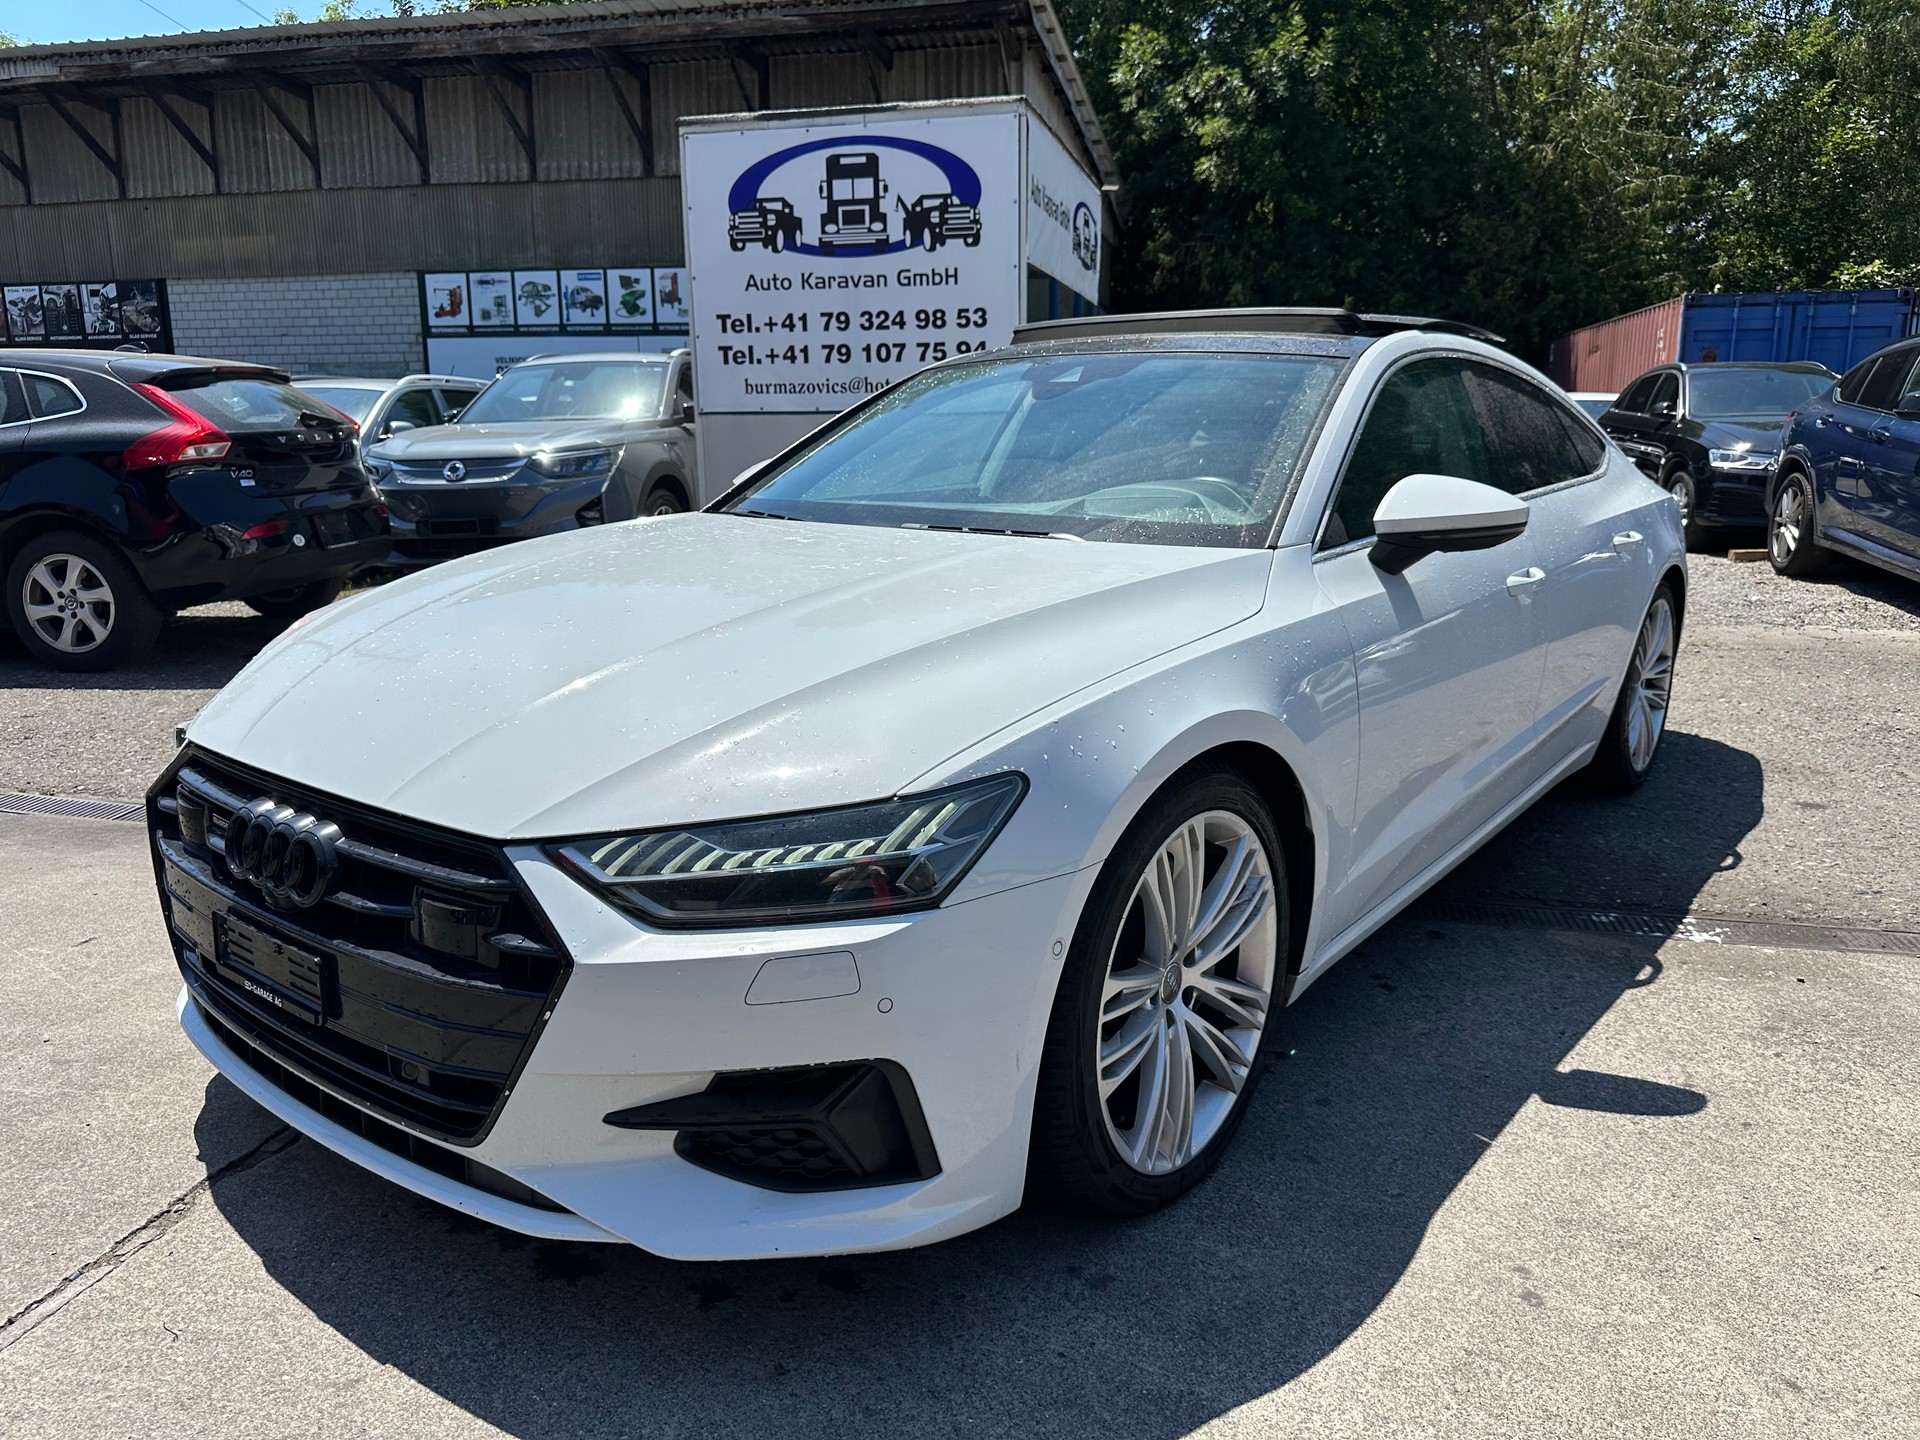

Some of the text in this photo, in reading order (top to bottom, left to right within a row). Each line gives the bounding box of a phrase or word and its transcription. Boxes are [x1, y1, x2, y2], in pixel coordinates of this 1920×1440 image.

[745, 267, 958, 292] Auto Karavan GmbH
[716, 307, 988, 334] Tel.+41 79 324 98 53
[717, 344, 809, 366] Tel.+41
[821, 343, 852, 365] 79
[862, 342, 907, 364] 107
[915, 341, 948, 363] 75
[230, 470, 253, 479] V40
[244, 980, 283, 1008] SD-GARAGE AG
